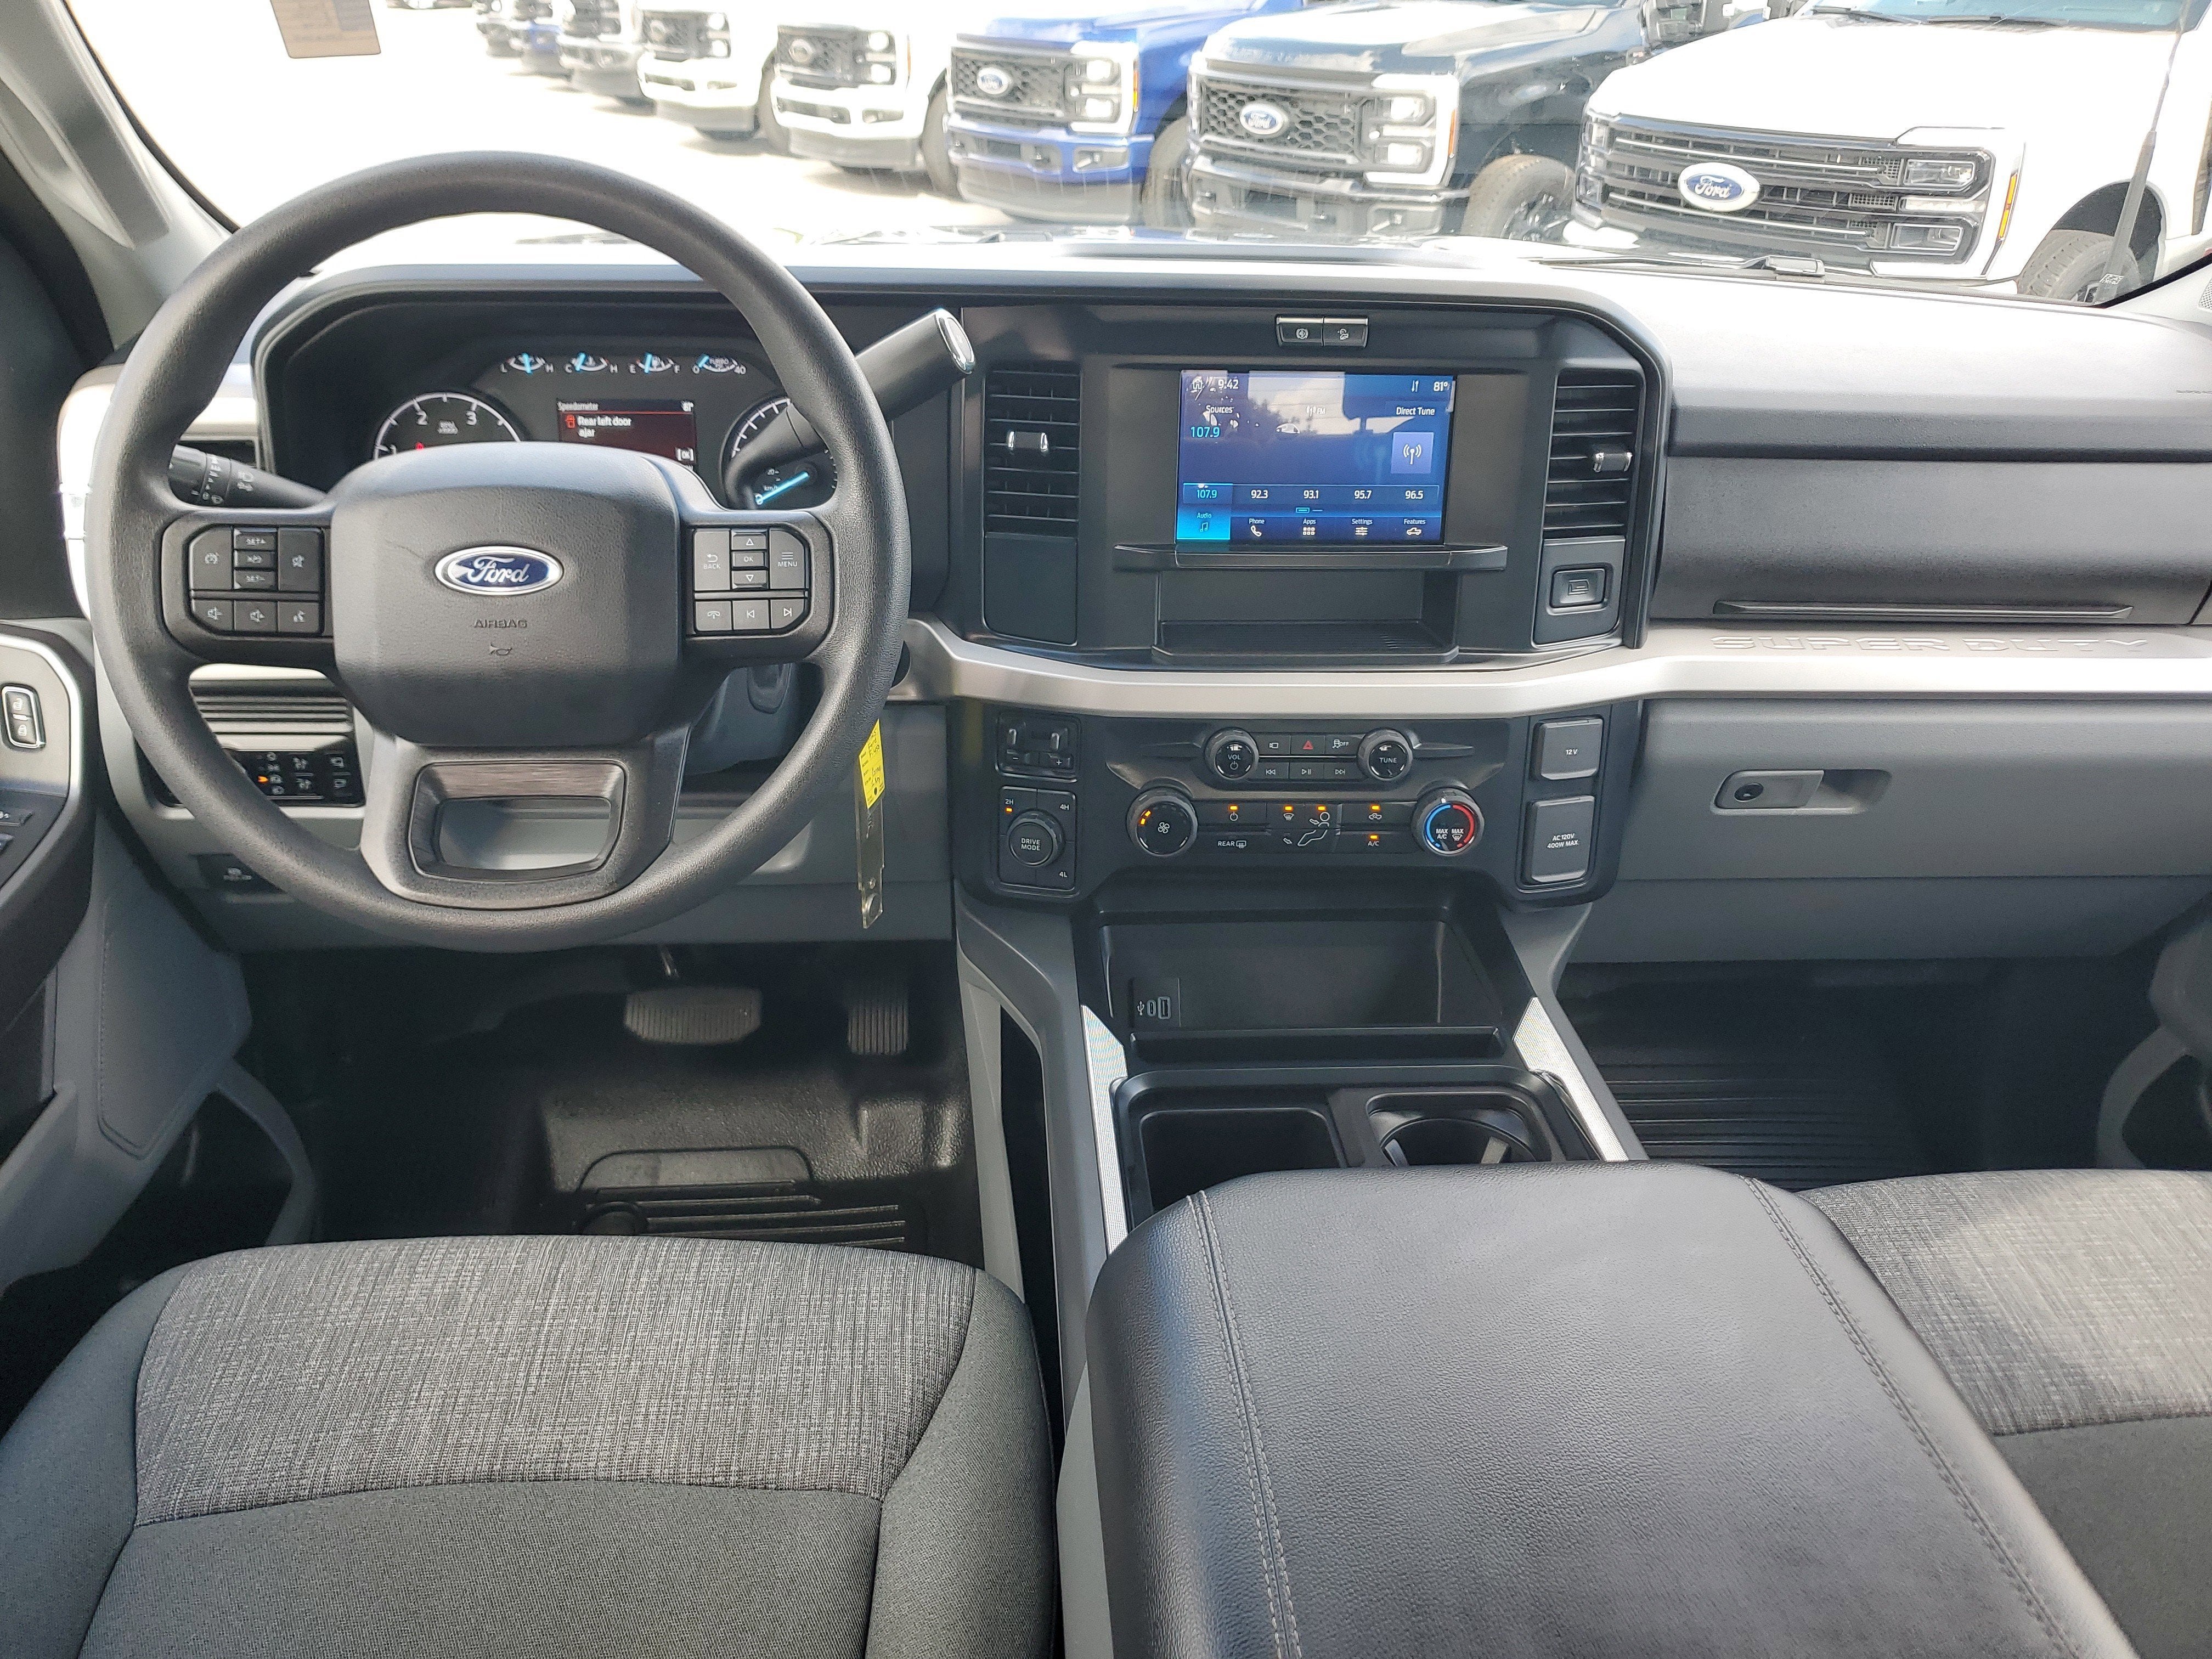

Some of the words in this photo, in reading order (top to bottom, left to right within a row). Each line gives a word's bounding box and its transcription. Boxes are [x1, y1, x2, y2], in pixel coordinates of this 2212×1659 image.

[1694, 174, 1731, 200] Ford
[1217, 379, 1239, 390] 9:42
[1206, 405, 1233, 414] Sources
[1396, 407, 1415, 415] Direct
[1417, 407, 1435, 415] Tune
[416, 411, 427, 425] 2
[466, 411, 477, 425] 3
[612, 416, 631, 426] door
[1190, 426, 1220, 438] 107.9
[1196, 489, 1217, 499] 107.9
[1251, 490, 1268, 500] 92.3
[1303, 490, 1319, 500] 93.1
[1354, 490, 1372, 500] 95.7
[1405, 490, 1424, 500] 96.5
[467, 556, 530, 584] Ford
[473, 618, 528, 629] AIRBAG
[1711, 636, 1951, 651] SUPER
[1962, 637, 2148, 652] DUTY
[1021, 838, 1041, 846] DRIVE
